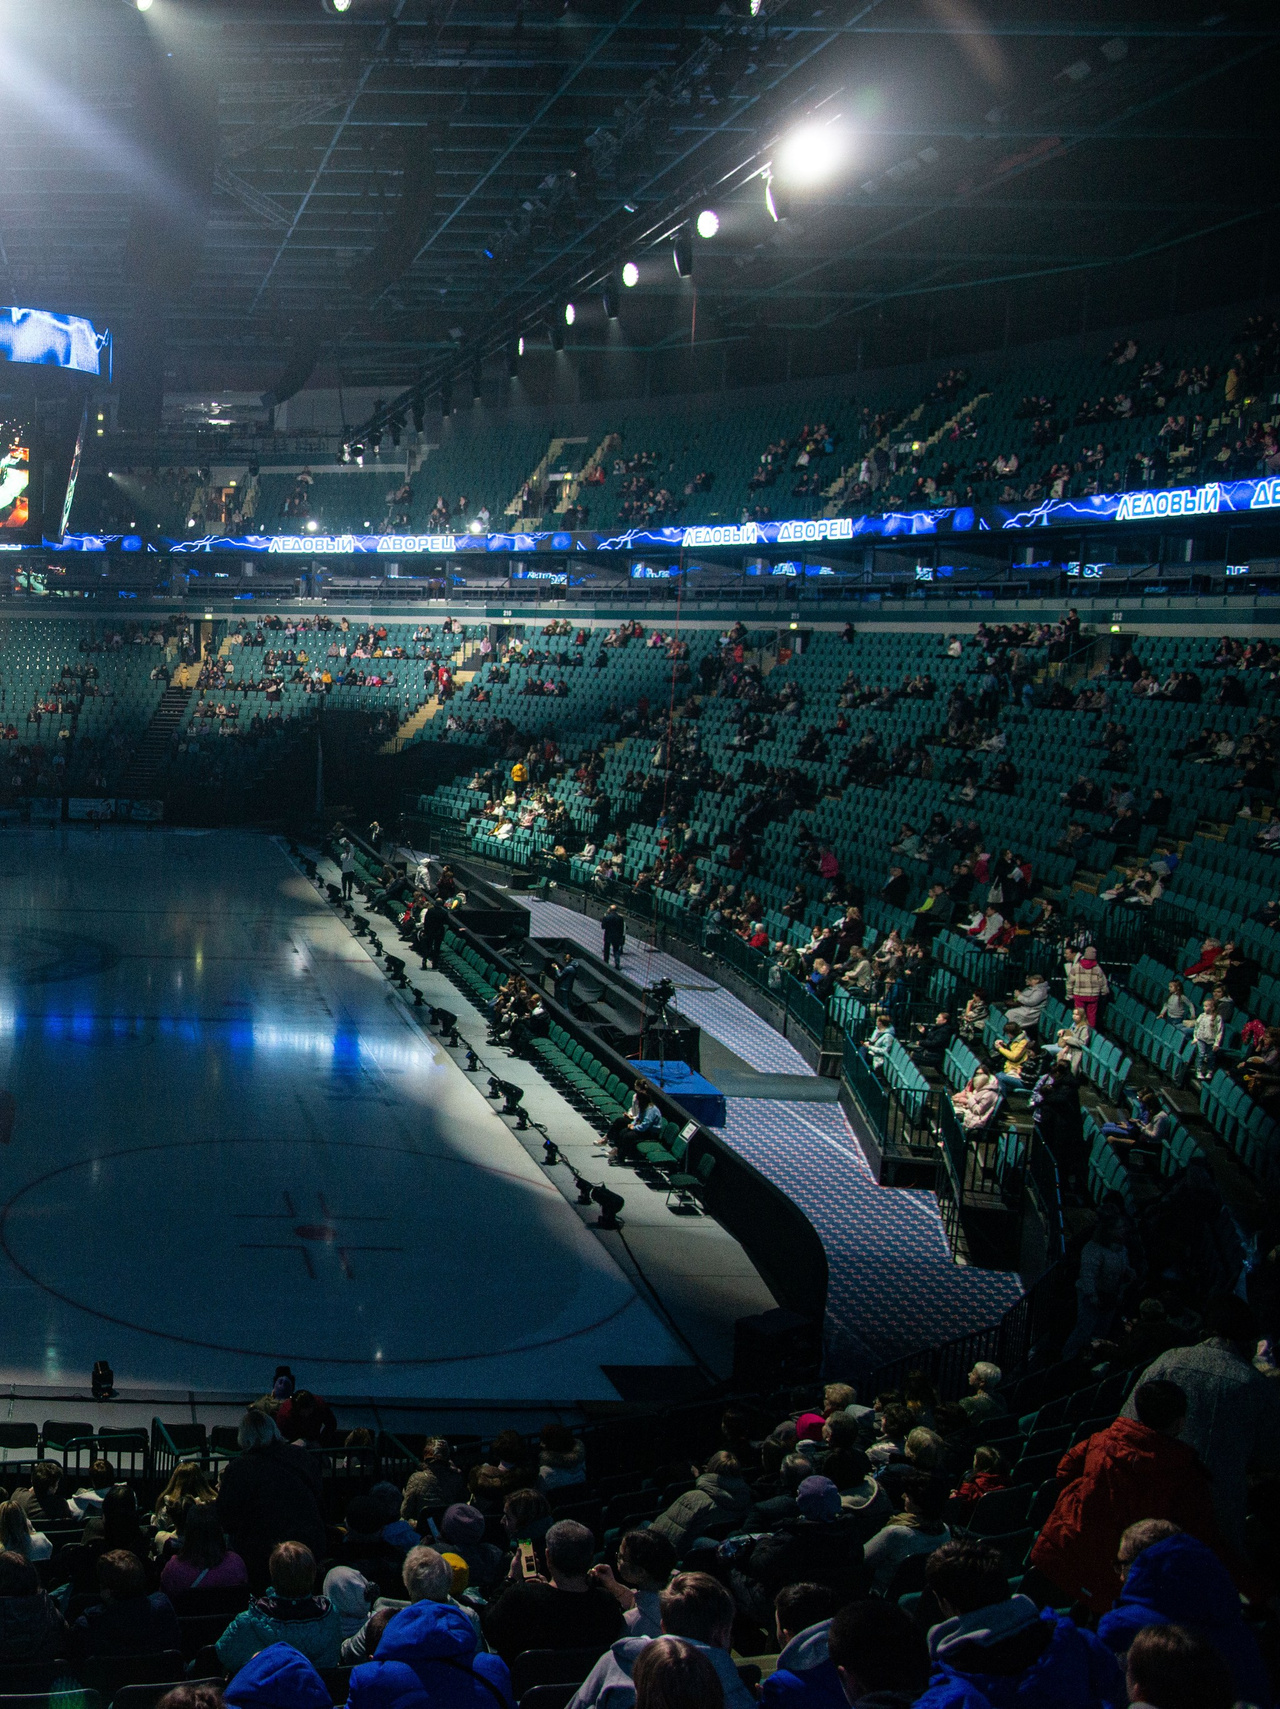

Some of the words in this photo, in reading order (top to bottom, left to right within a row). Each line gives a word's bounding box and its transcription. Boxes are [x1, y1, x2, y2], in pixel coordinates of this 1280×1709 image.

[1115, 482, 1220, 520] ЛЕДОВЫЙ
[268, 535, 354, 553] ЛЕДОВЫЙ
[377, 535, 456, 552] ДВОРЕЦ
[682, 521, 758, 546] ЛЕДОВЫЙ
[778, 518, 853, 542] ДВОРЕЦ
